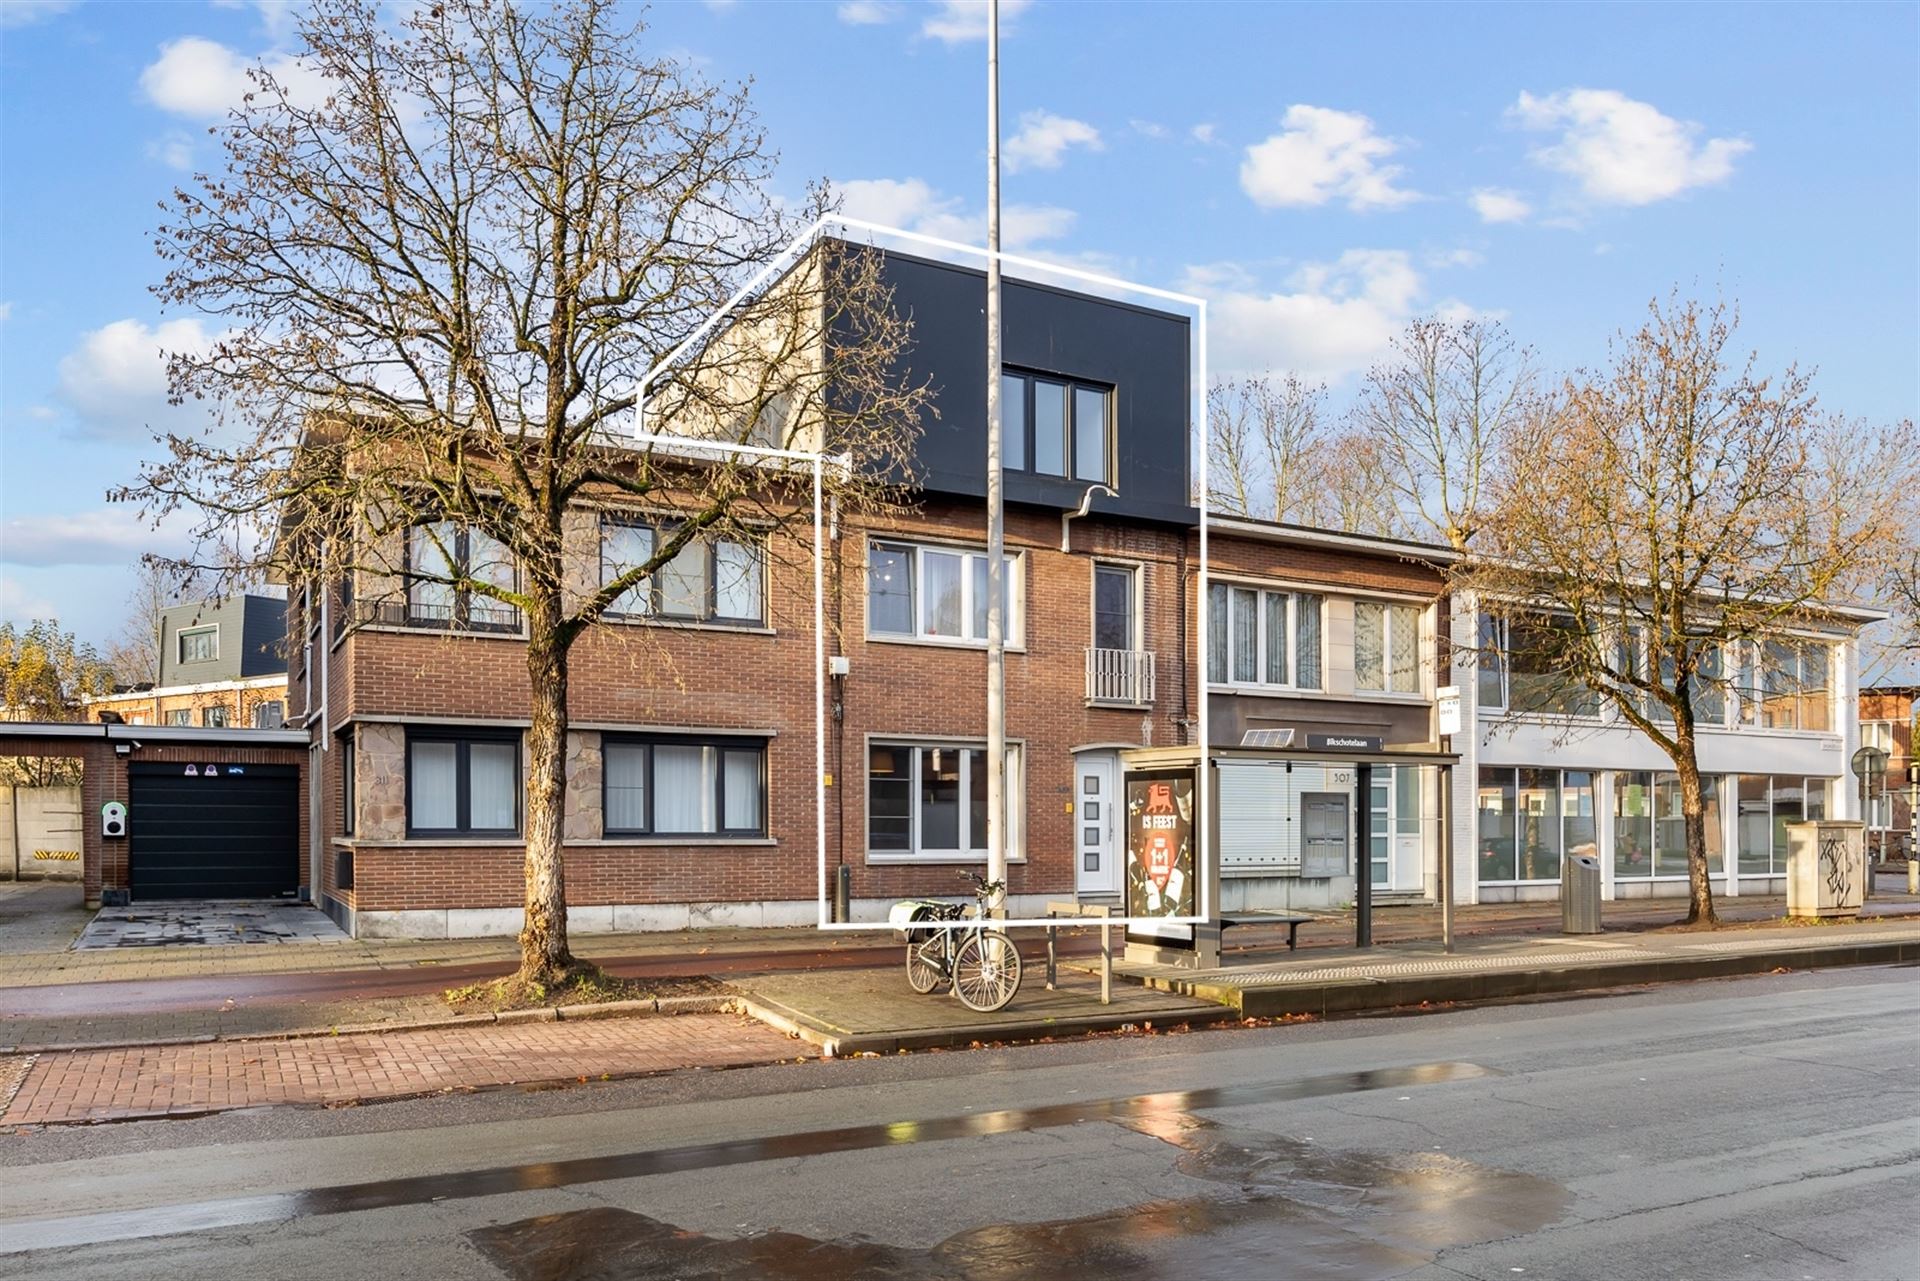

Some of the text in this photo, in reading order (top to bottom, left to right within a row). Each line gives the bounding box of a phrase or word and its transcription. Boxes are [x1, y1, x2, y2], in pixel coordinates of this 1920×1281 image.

[1142, 814, 1178, 829] IS FEEST
[1150, 848, 1169, 866] 1+1
